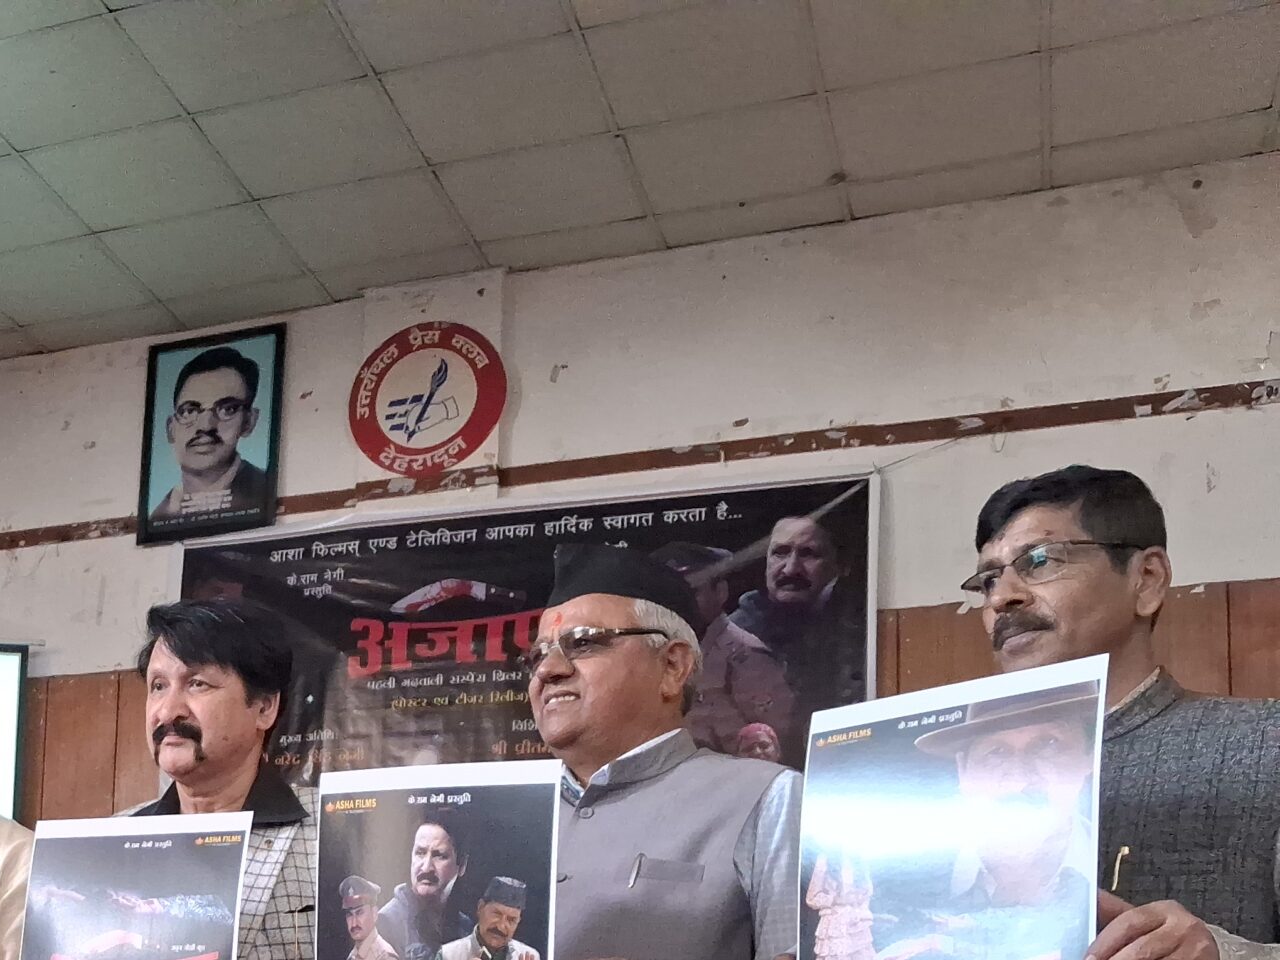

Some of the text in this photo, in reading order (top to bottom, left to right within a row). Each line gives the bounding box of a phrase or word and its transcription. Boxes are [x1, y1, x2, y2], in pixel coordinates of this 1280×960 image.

[408, 328, 440, 350] प्रेस
[452, 334, 489, 369] क्लब
[379, 436, 467, 472] देहरादून
[270, 547, 304, 563] आशा
[312, 540, 360, 558] फिल्मस्
[369, 536, 398, 553] एण्ड
[406, 528, 477, 548] टेलिविजन
[485, 522, 535, 541] आपका
[544, 514, 593, 537] हार्दिक
[603, 512, 654, 531] स्वागत
[663, 507, 707, 525] करता
[323, 567, 345, 582] नेगी
[303, 583, 333, 600] प्रस्तुति
[367, 676, 396, 690] पहली
[449, 671, 487, 684] सस्पेंस
[492, 669, 522, 682] थ्रिलर
[511, 718, 538, 732] विशि
[279, 733, 302, 747] मुख्य
[826, 728, 872, 744] ASHA FILMS
[491, 739, 508, 755] श्री
[335, 798, 377, 810] ASHA FILMS
[204, 834, 242, 844] ASHA FILMS
